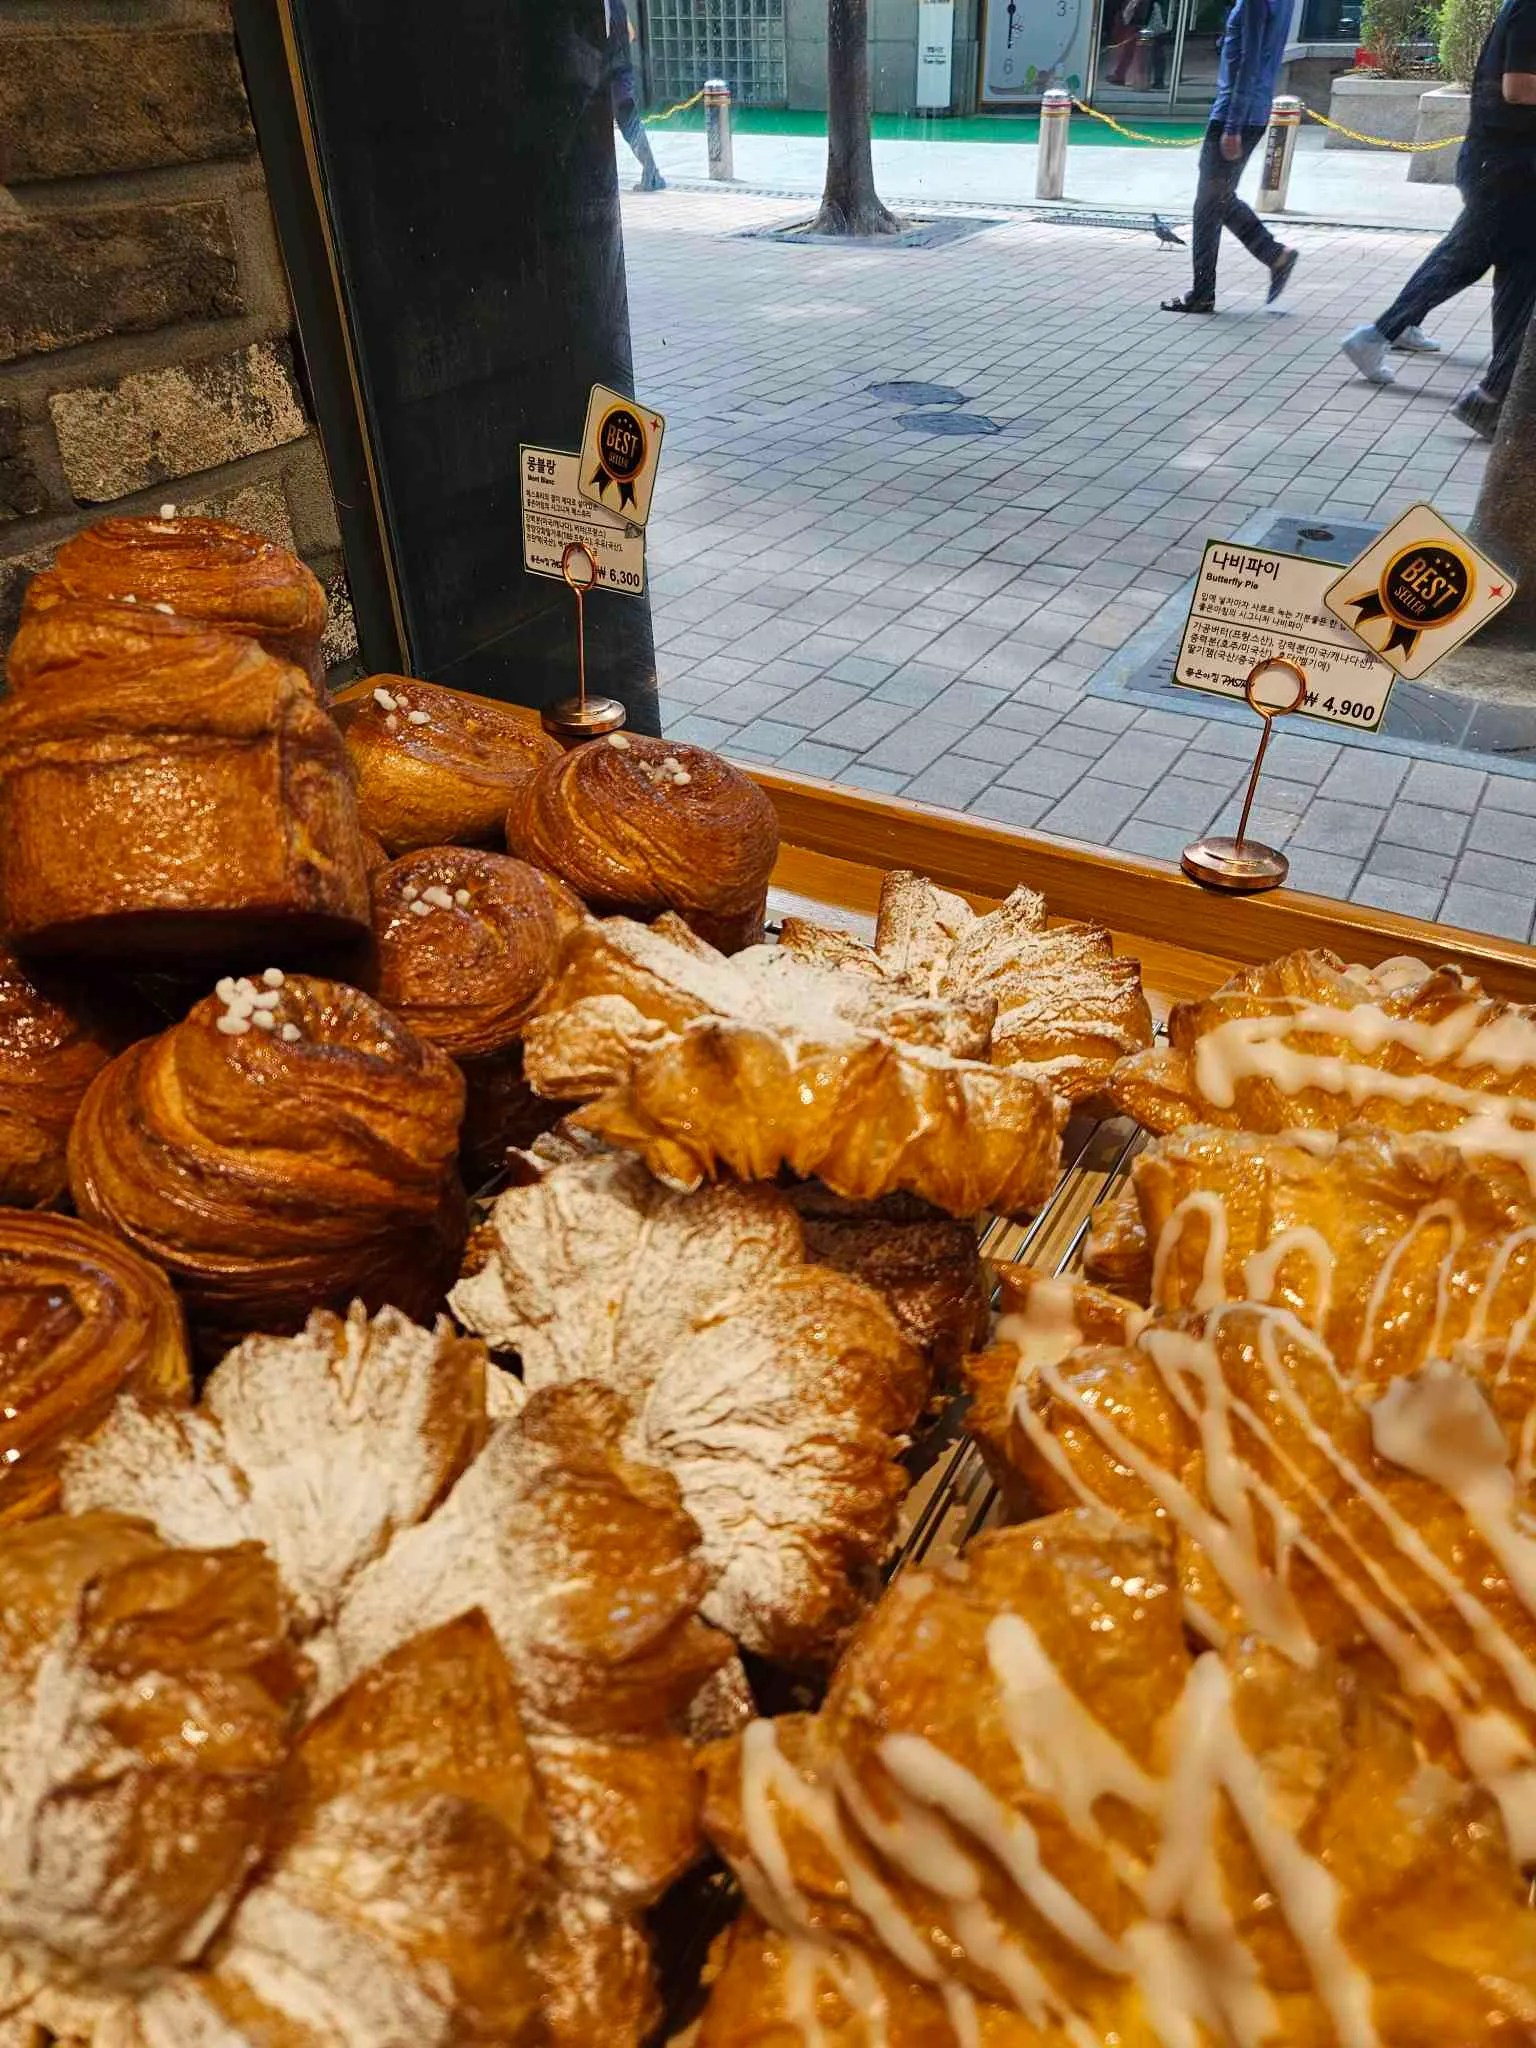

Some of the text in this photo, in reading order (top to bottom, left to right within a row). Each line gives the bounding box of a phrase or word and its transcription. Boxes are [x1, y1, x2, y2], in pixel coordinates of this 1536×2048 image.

[1057, 1, 1066, 17] 3
[1003, 58, 1013, 74] 6
[606, 424, 639, 458] BEST
[527, 456, 556, 475] 몽블랑
[610, 568, 640, 587] 6,300
[1212, 551, 1280, 581] 나비파이
[1206, 572, 1259, 590] Butterfly Pie
[1400, 557, 1459, 608] BEST
[1201, 592, 1217, 603] 입에
[1251, 603, 1275, 614] 사르르
[1393, 585, 1426, 616] SELLER
[1199, 603, 1304, 632] 좋은아침의 시그니처 나비파이
[1323, 696, 1375, 721] 4,900
